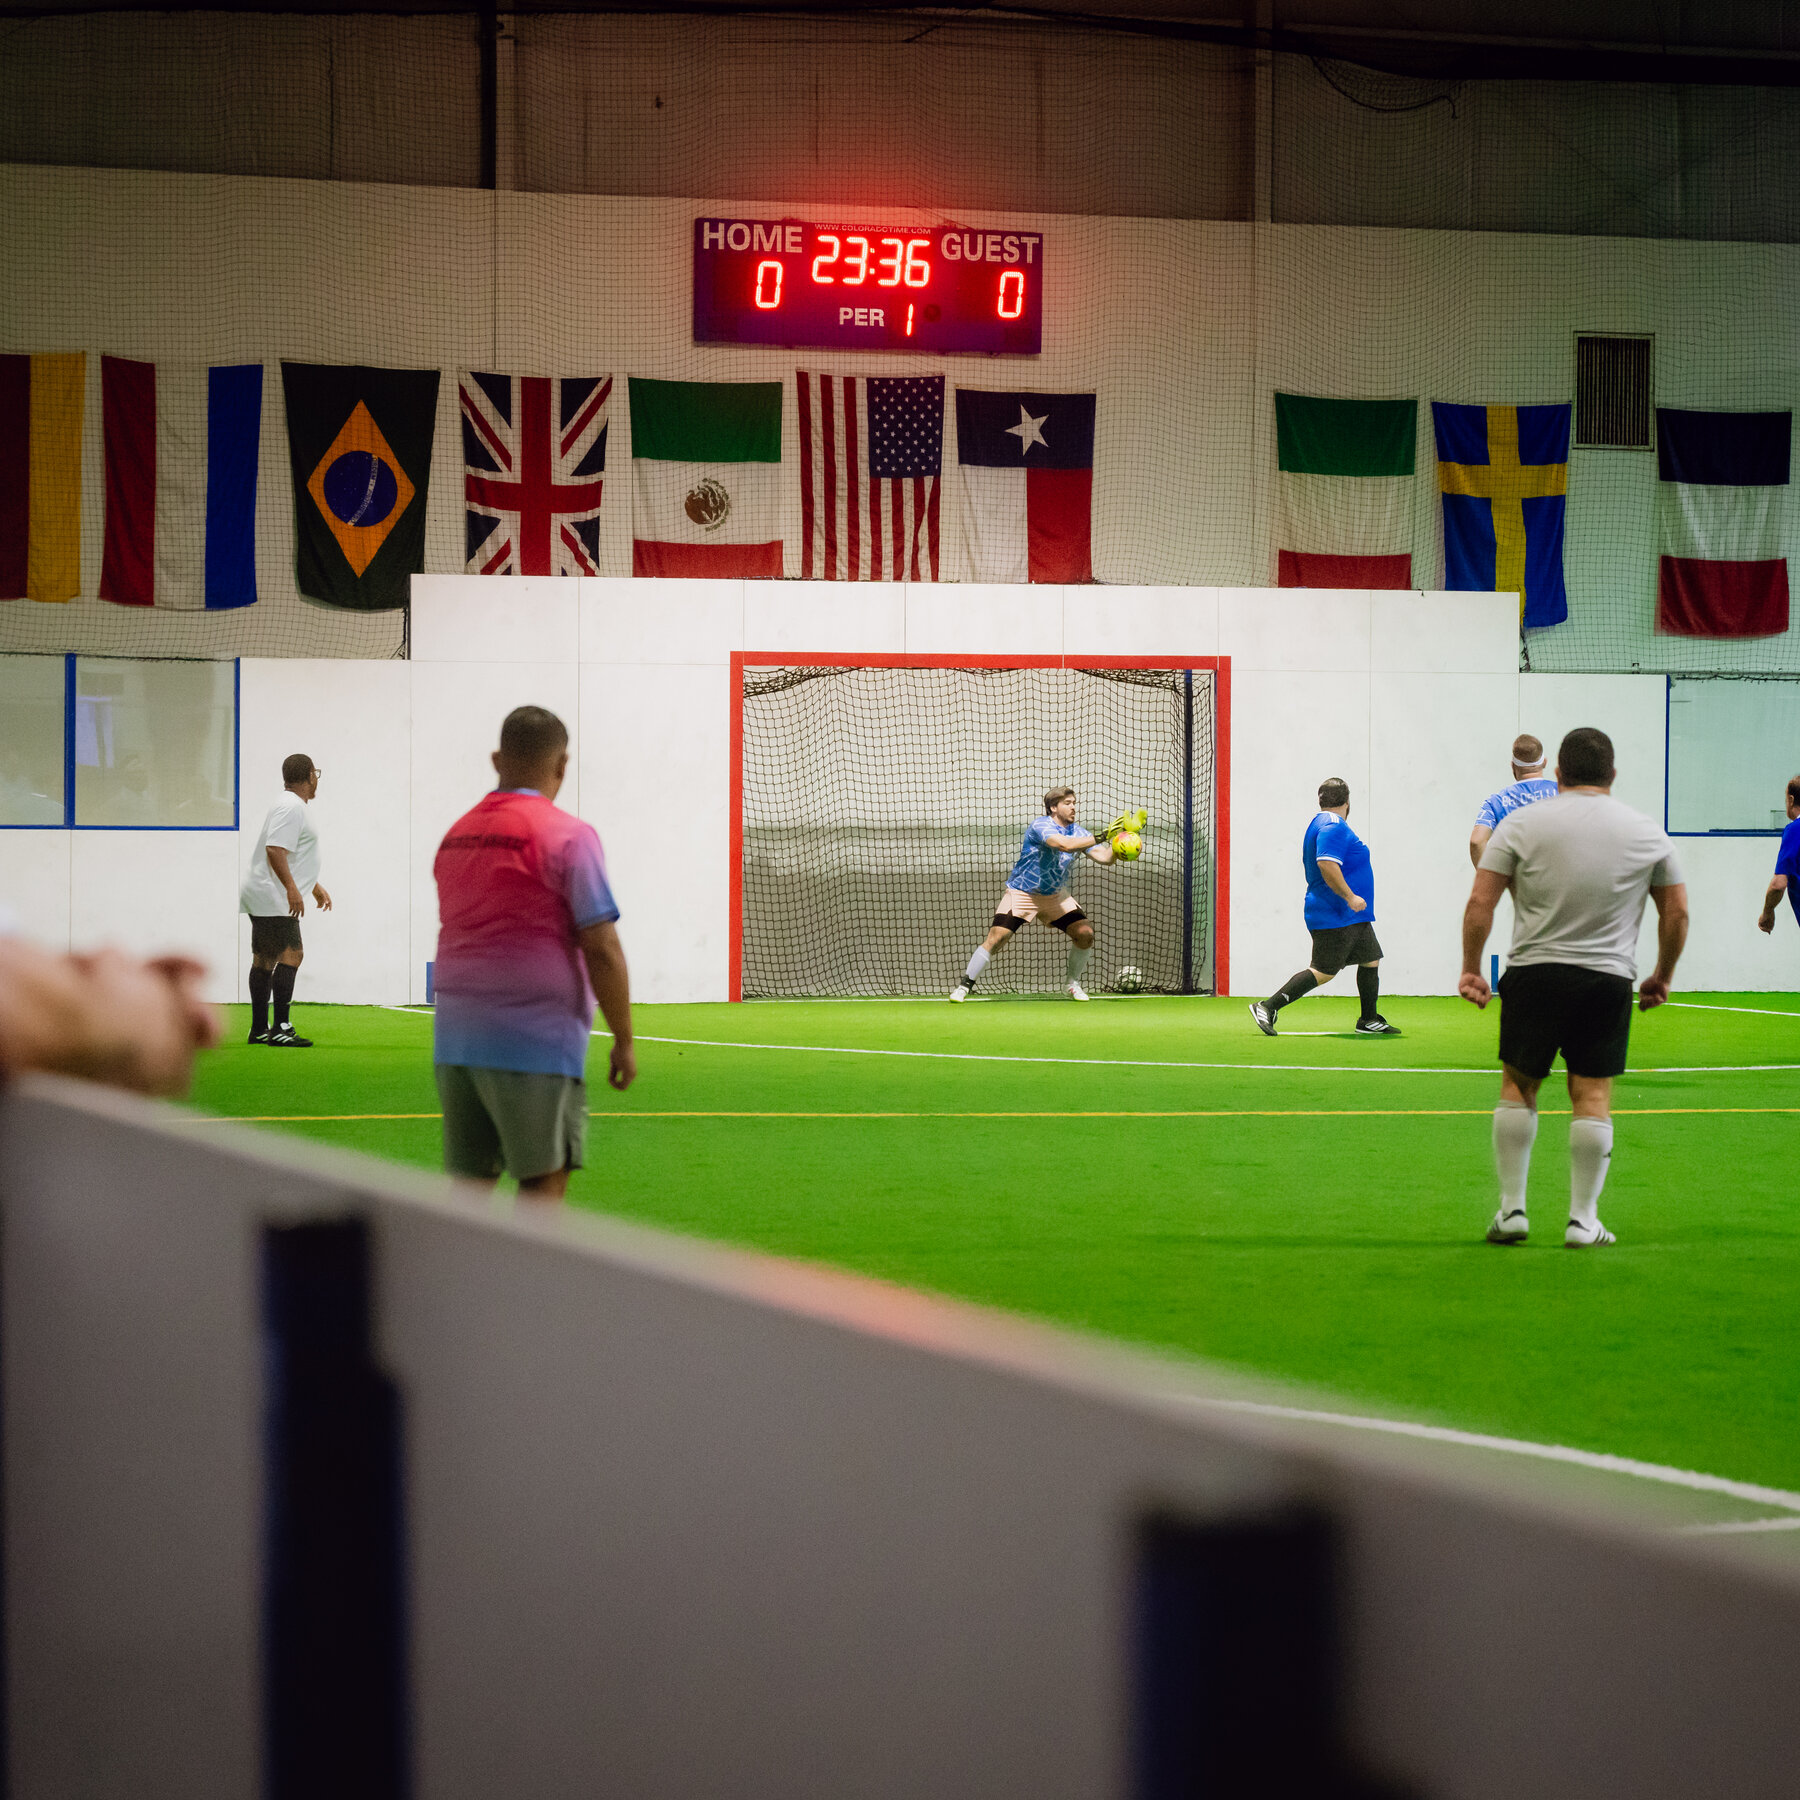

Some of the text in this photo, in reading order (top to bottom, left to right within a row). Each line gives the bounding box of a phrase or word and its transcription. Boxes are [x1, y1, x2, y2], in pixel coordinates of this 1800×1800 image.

[703, 221, 803, 253] HOME
[941, 232, 1040, 264] GUEST
[811, 234, 931, 288] 23:36
[755, 260, 783, 309] 0
[997, 271, 1024, 318] 0
[839, 303, 914, 335] PER 1
